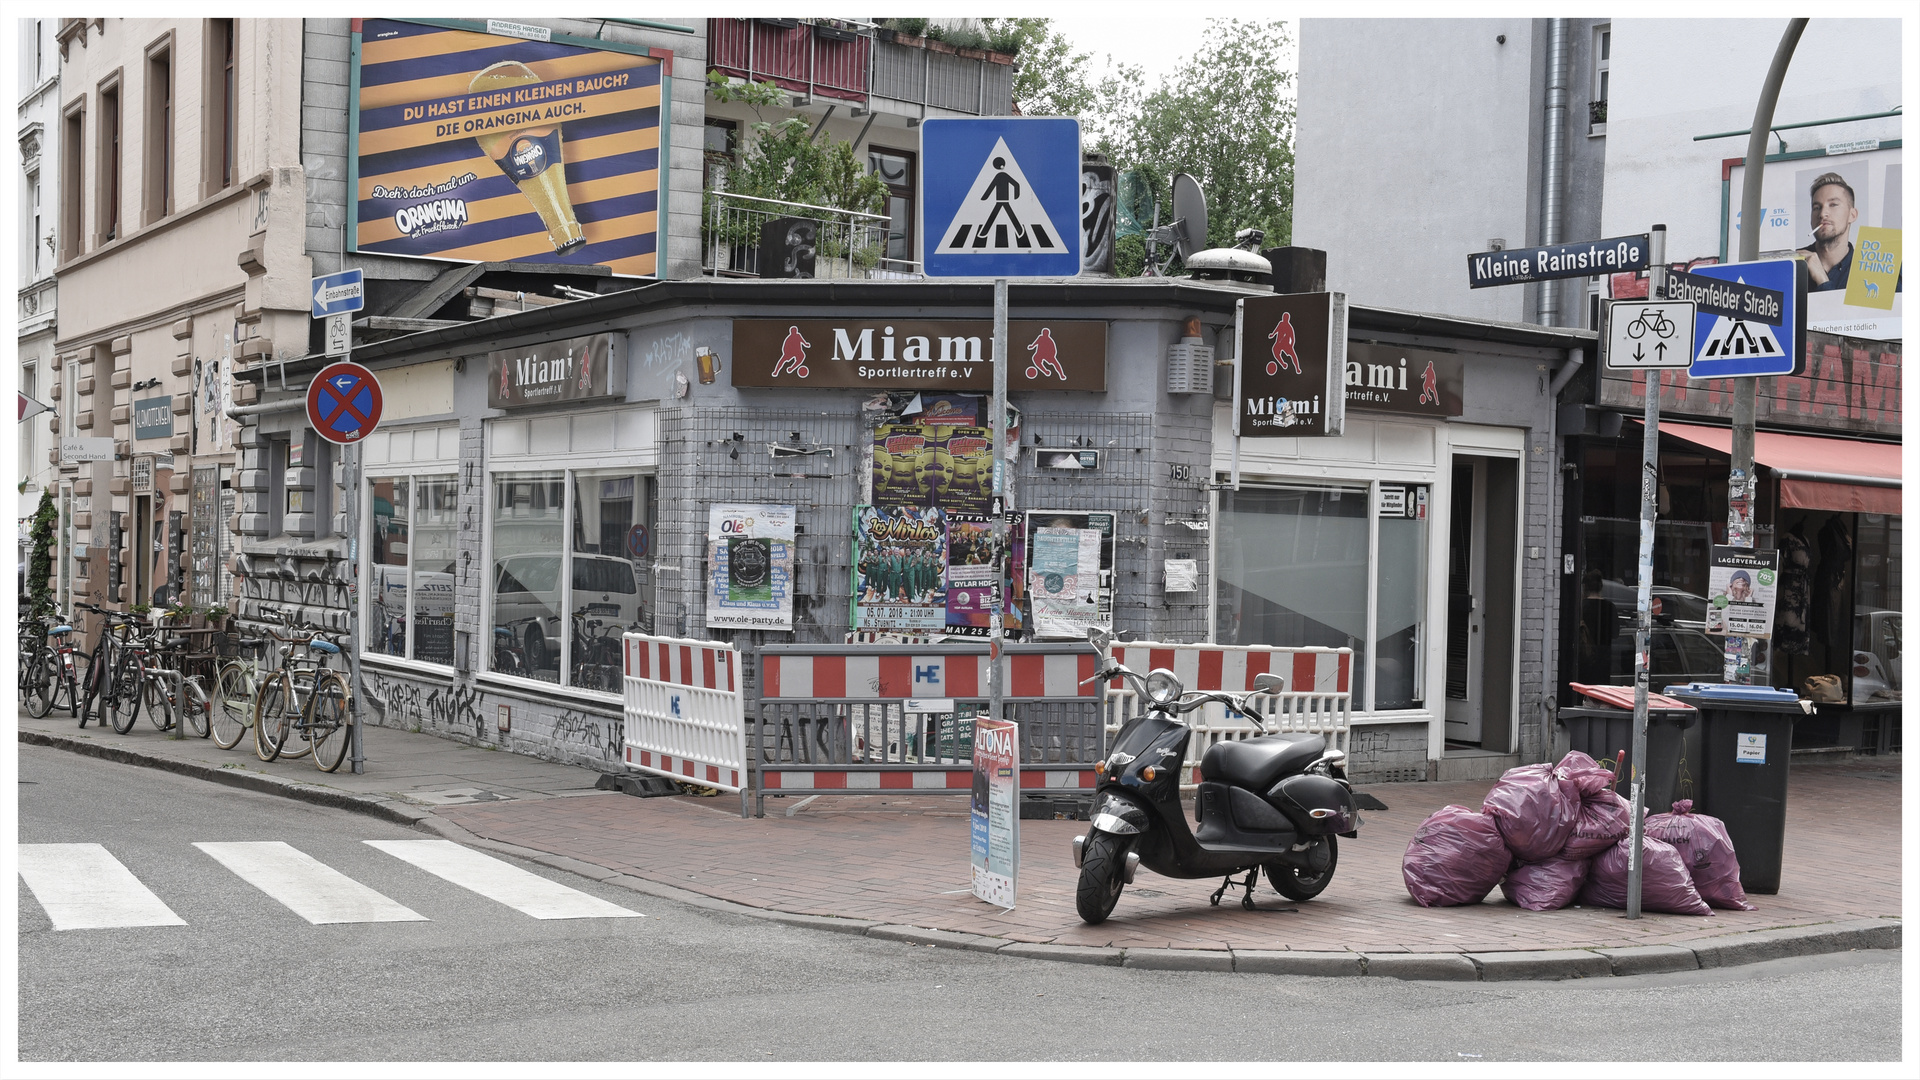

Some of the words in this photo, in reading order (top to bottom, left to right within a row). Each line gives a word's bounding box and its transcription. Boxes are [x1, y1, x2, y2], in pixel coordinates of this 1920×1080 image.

[492, 21, 521, 31] ANDREAS
[522, 26, 547, 34] HANSEN
[403, 106, 424, 121] DU
[428, 99, 465, 118] HAST
[468, 92, 512, 111] EINEN
[515, 82, 573, 103] KLEINEN
[576, 73, 630, 93] BAUCH?
[436, 123, 459, 137] DIE
[464, 109, 541, 132] ORANGINA
[544, 102, 586, 119] AUCH.
[373, 186, 409, 199] Dreh's
[409, 184, 436, 198] doch
[436, 176, 458, 194] mal
[458, 172, 477, 186] um.
[395, 199, 468, 233] ORANGINA
[1770, 217, 1789, 228] 10€
[421, 221, 463, 235] Fruchtfleisch!
[1862, 240, 1881, 251] DO
[1475, 255, 1530, 280] Kleine
[1537, 242, 1640, 273] Rainstraße
[1860, 250, 1894, 263] YOUR
[1858, 261, 1894, 275] THING
[325, 286, 360, 300] Einbahnstraße
[1668, 274, 1741, 311] Bahrenfelder
[1744, 290, 1779, 318] Straße
[1853, 322, 1877, 331] tödlich
[515, 348, 573, 386] Miami
[858, 366, 947, 379] Sportlertreff
[950, 367, 973, 378] e.V
[1345, 357, 1408, 391] ami
[1345, 391, 1374, 401] ertreff
[1375, 392, 1390, 403] e.V.
[1247, 395, 1320, 415] Mimi
[1300, 418, 1314, 426] e.V.
[994, 461, 1003, 491] STEASY
[1171, 465, 1189, 480] 150
[721, 519, 744, 533] Olé
[868, 517, 886, 534] Los
[881, 517, 939, 541] Mirlos
[1718, 557, 1770, 566] LAGERVERKAUF
[1759, 572, 1773, 582] 70%
[713, 615, 785, 625] www.ole-party.de
[889, 608, 903, 618] 2018
[910, 609, 923, 618] 21:00
[924, 609, 935, 617] UHR
[874, 620, 896, 628] STUBNITZ
[971, 627, 983, 635] 25
[986, 628, 1010, 637] 28
[916, 665, 940, 683] HE
[670, 695, 681, 715] HE
[974, 726, 1013, 757] ALTONA
